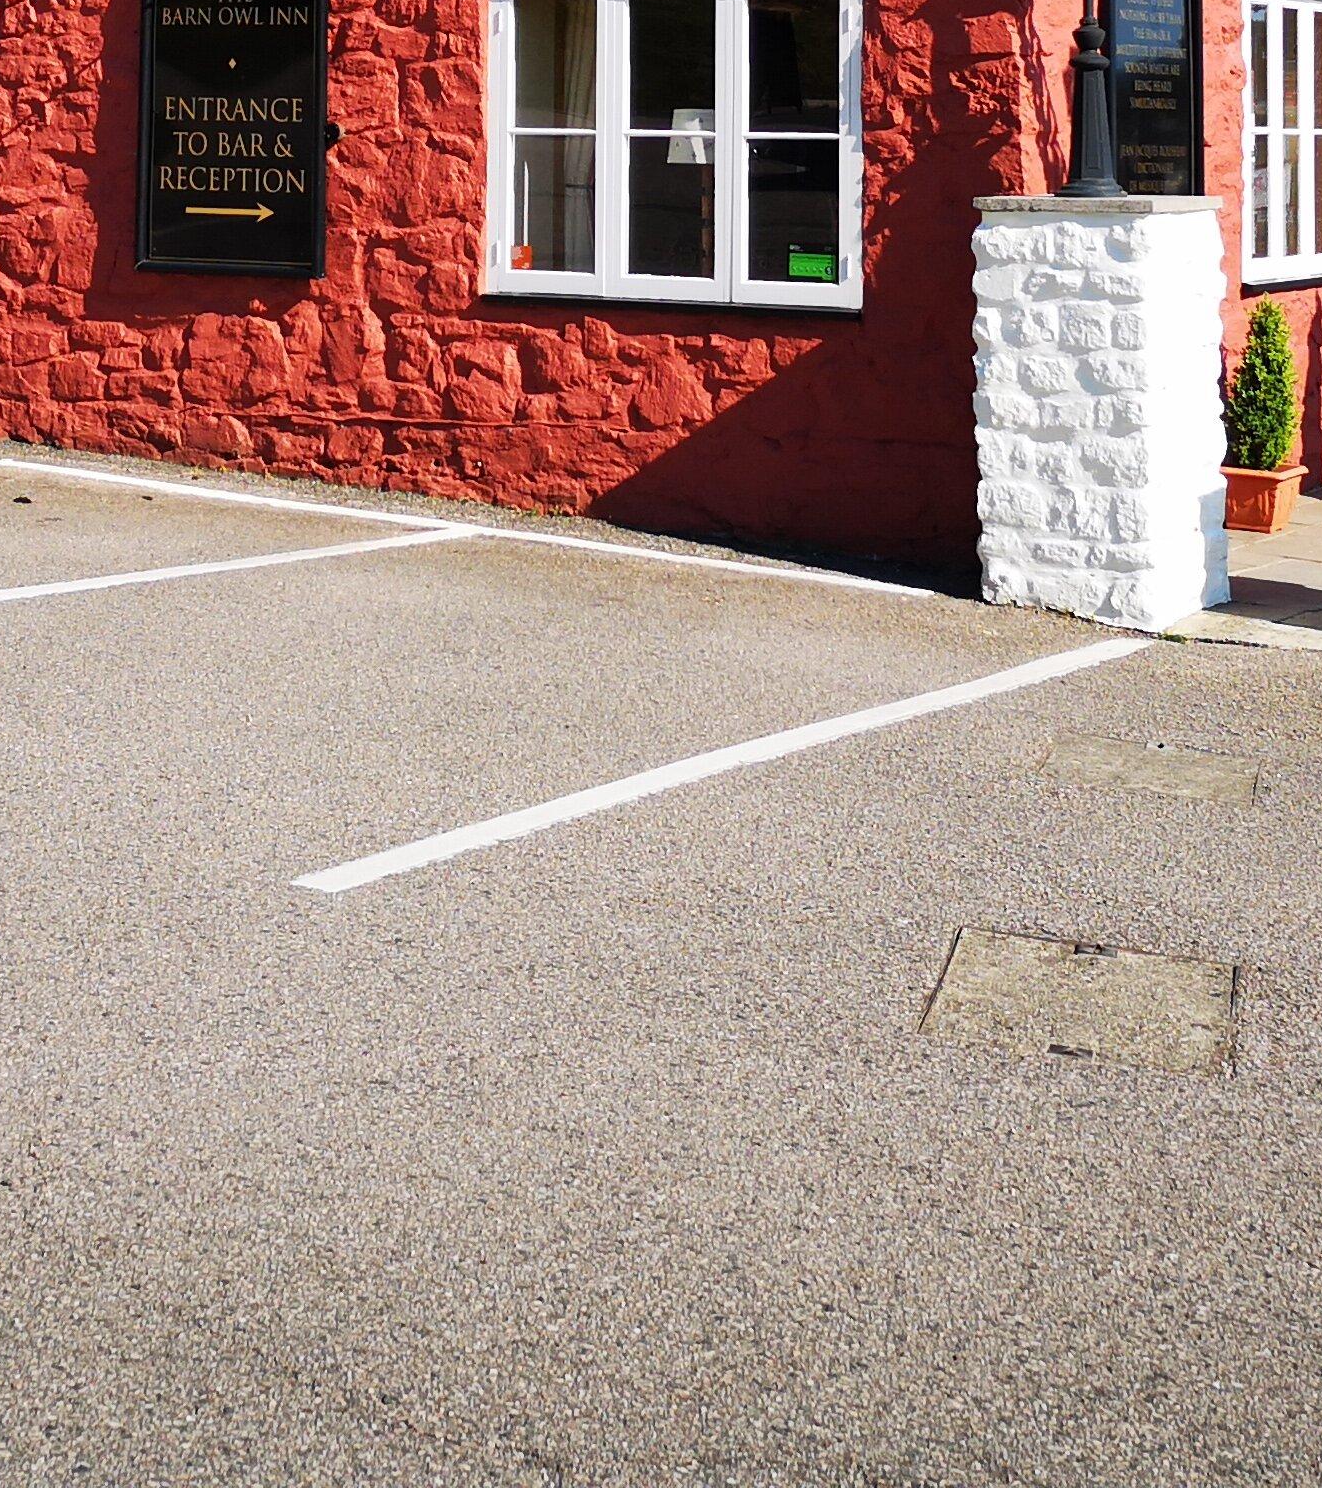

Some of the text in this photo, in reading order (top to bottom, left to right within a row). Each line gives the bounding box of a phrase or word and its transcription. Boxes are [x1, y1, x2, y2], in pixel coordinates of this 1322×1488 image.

[162, 6, 307, 26] BARN OWL INN
[165, 96, 303, 123] ENTRANCE
[173, 131, 294, 158] TO BAR &
[160, 165, 305, 193] RECEPTION
